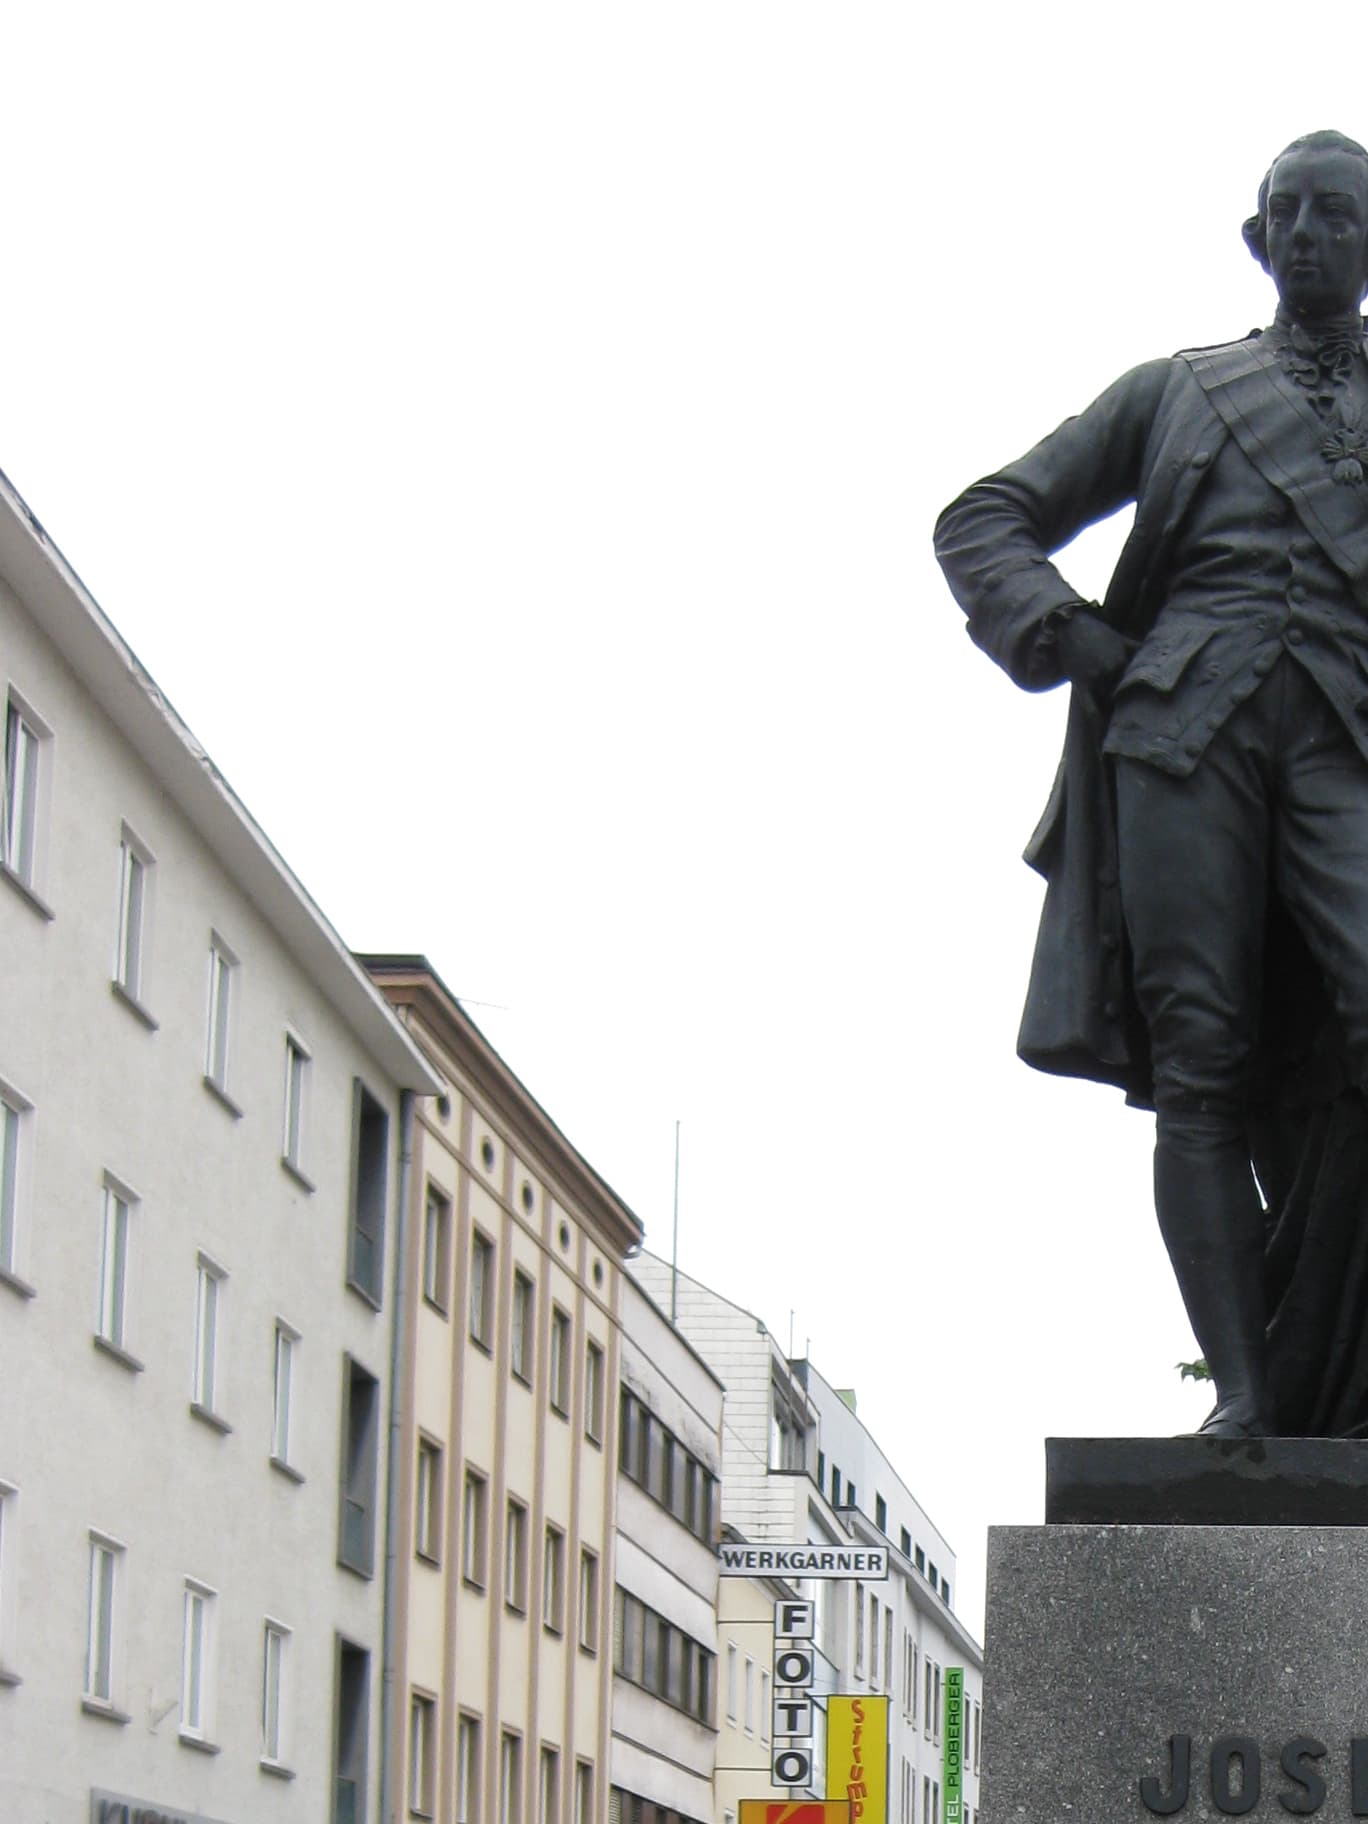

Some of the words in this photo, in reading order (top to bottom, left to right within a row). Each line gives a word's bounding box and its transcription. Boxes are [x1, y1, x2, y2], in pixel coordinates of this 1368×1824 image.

[723, 1551, 882, 1571] WERKGARNER
[776, 1605, 810, 1783] FOTO
[947, 1672, 960, 1787] PLOBERGER
